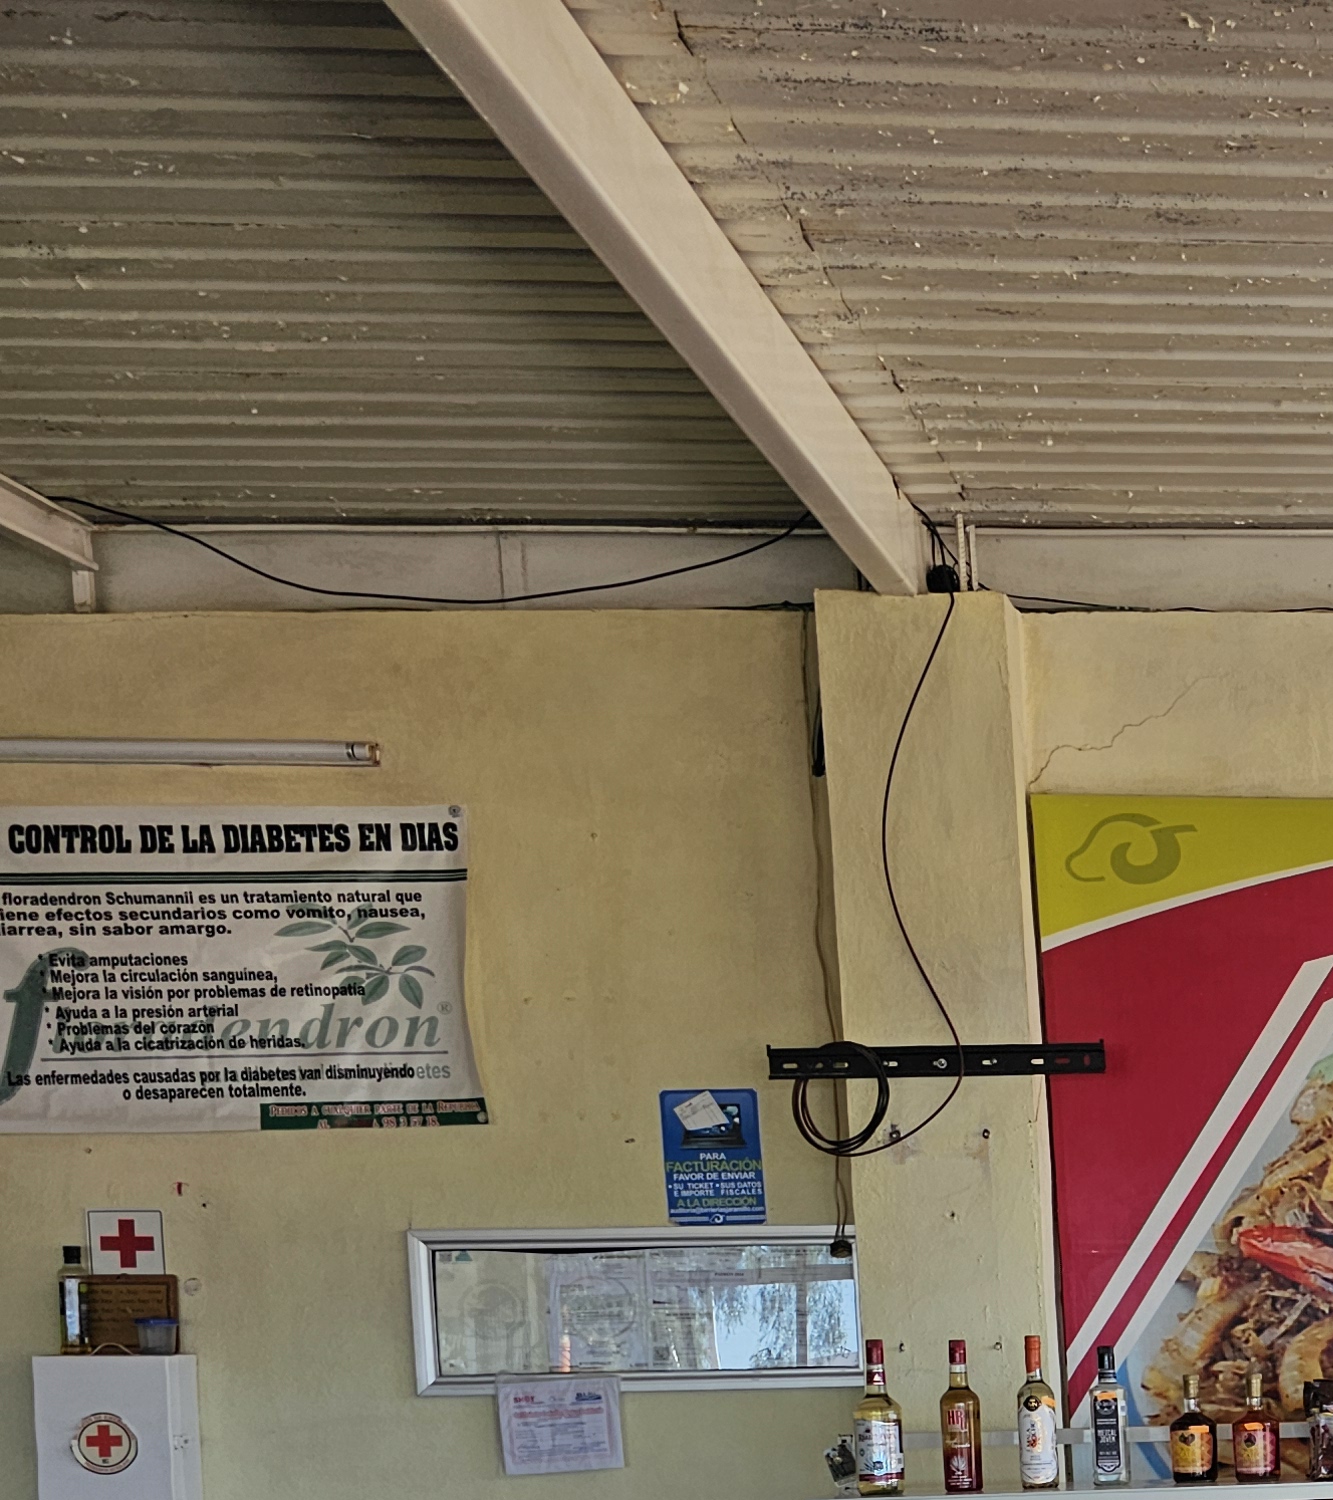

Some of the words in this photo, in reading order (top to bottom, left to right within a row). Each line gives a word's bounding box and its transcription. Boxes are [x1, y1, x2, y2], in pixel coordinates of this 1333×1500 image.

[8, 824, 132, 854] CONTROL
[139, 824, 175, 854] DE
[181, 824, 216, 853] LA
[222, 823, 351, 853] DIABETES
[358, 823, 392, 851] EN
[400, 822, 459, 851] DIAS
[2, 892, 101, 906] floradendron
[199, 895, 216, 904] es
[220, 894, 239, 904] un
[243, 890, 332, 904] tratamiento
[337, 890, 390, 903] natural
[395, 891, 423, 905] que
[45, 908, 113, 921] efectos
[119, 908, 227, 921] secundarios
[232, 908, 281, 920] como
[0, 924, 63, 938] iarrea,
[69, 924, 97, 936] sin
[102, 923, 153, 936] sabor
[159, 924, 232, 938] amargo.
[50, 953, 86, 967] Evita
[89, 953, 188, 969] amputaciones
[51, 970, 99, 986] Mejora
[103, 970, 116, 983] la
[120, 968, 198, 983] circulación
[203, 966, 277, 985] sanguínea,
[52, 987, 100, 1003] Mejora
[105, 987, 118, 1000] la
[122, 985, 161, 1000] visión
[168, 988, 190, 1002] por
[194, 984, 266, 1002] problemas
[270, 984, 287, 997] de
[291, 982, 366, 999] retinopatía
[56, 1006, 98, 1022] Ayuda
[101, 1010, 110, 1019] a
[115, 1005, 128, 1019] la
[132, 1004, 184, 1021] presión
[188, 1004, 239, 1018] arterial
[58, 1022, 130, 1036] Problemas
[134, 1021, 155, 1034] del
[59, 1038, 101, 1055] Ayuda
[106, 1042, 114, 1051] a
[116, 1037, 130, 1051] la
[134, 1035, 225, 1050] cicatrización
[229, 1036, 246, 1049] de
[250, 1035, 305, 1049] heridas.
[7, 1071, 31, 1087] Las
[35, 1069, 130, 1086] enfermedades
[133, 1068, 196, 1083] causadas
[201, 1070, 220, 1085] por
[224, 1067, 237, 1082] la
[241, 1066, 297, 1082] diabetes
[300, 1068, 322, 1080] van
[325, 1063, 415, 1082] disminuyendo
[123, 1090, 131, 1100] o
[135, 1086, 224, 1103] desaparecen
[229, 1083, 306, 1099] totalmente.
[699, 1152, 727, 1161] PARA
[666, 1157, 763, 1173] FACTURACIÓN
[673, 1172, 704, 1181] FAVOR
[706, 1172, 719, 1181] DE
[721, 1171, 756, 1180] ENVIAR
[673, 1182, 684, 1190] SU
[688, 1182, 714, 1190] TICKET
[720, 1181, 736, 1189] SUS
[737, 1181, 762, 1189] DATOS
[720, 1188, 763, 1196] FISCALES
[677, 1199, 686, 1208] A
[687, 1199, 699, 1208] LA
[702, 1196, 757, 1207] DIRECCIÓN
